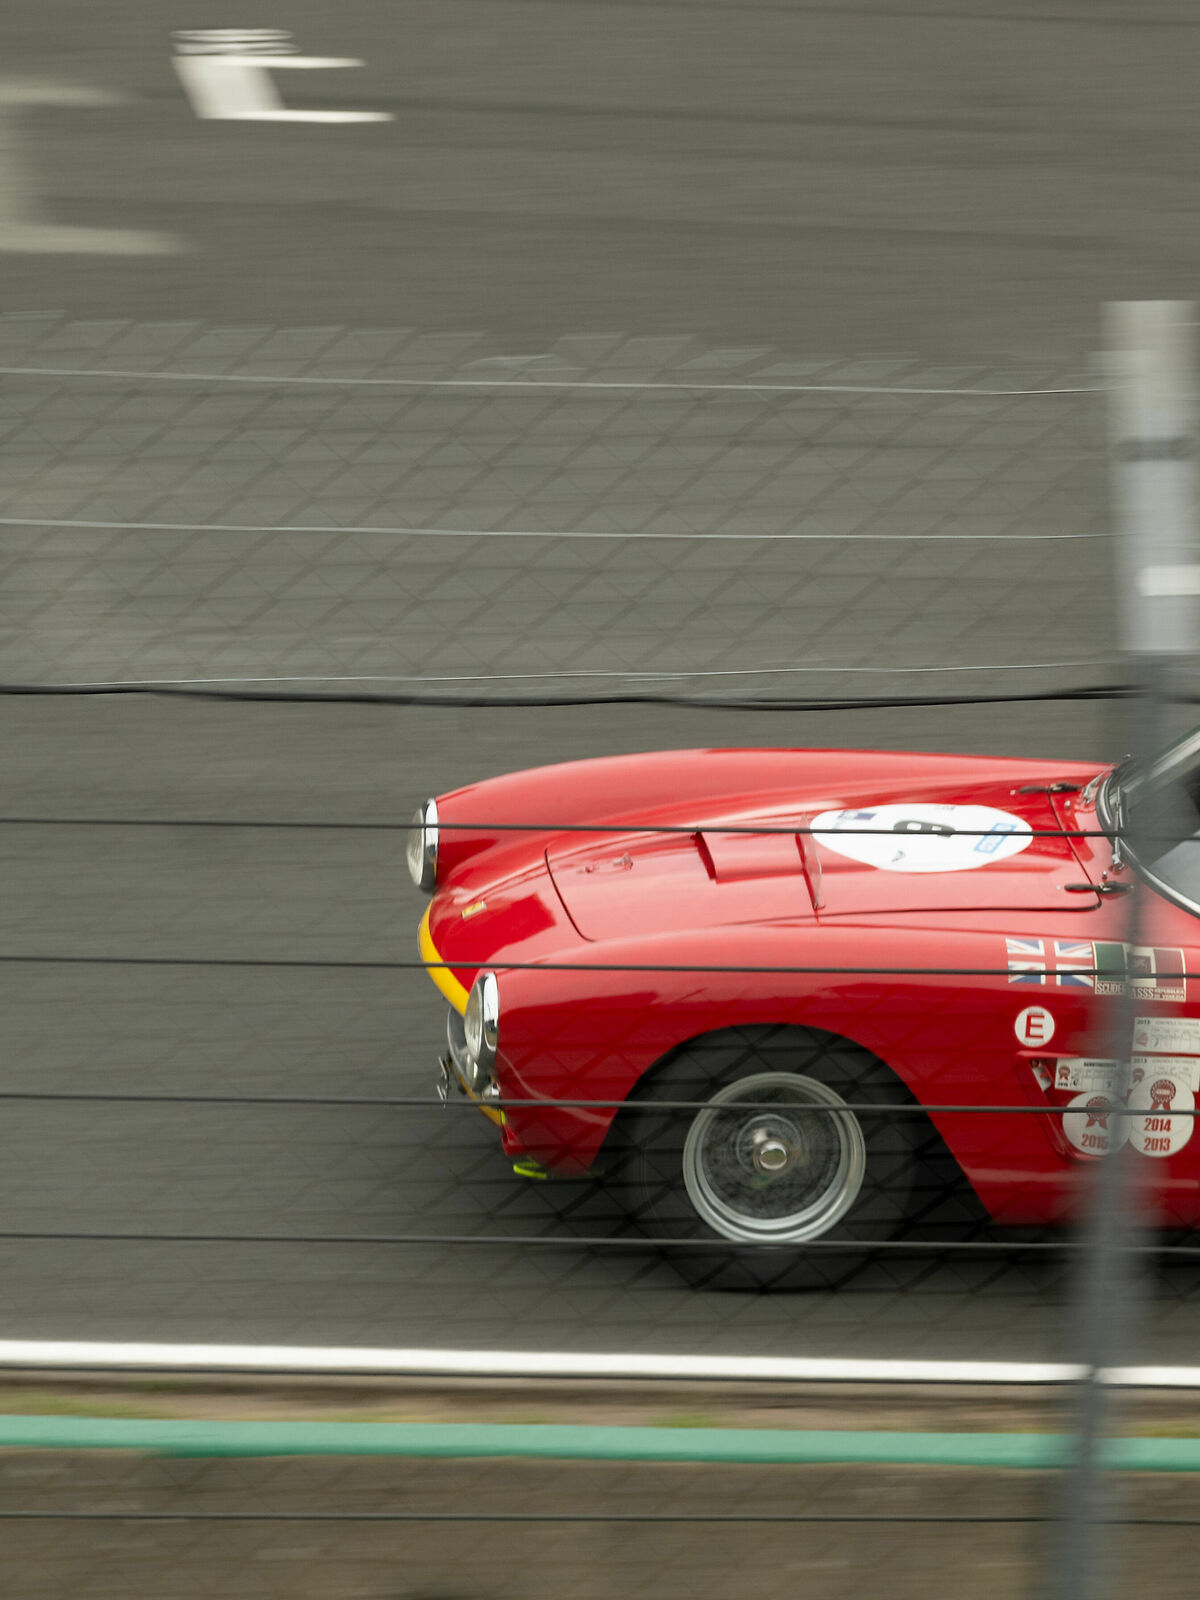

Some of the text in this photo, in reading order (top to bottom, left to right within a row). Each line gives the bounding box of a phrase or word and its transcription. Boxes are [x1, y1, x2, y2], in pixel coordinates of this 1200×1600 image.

[1025, 1014, 1045, 1039] E
[1143, 1117, 1171, 1132] 2014
[1143, 1137, 1171, 1151] 2013
